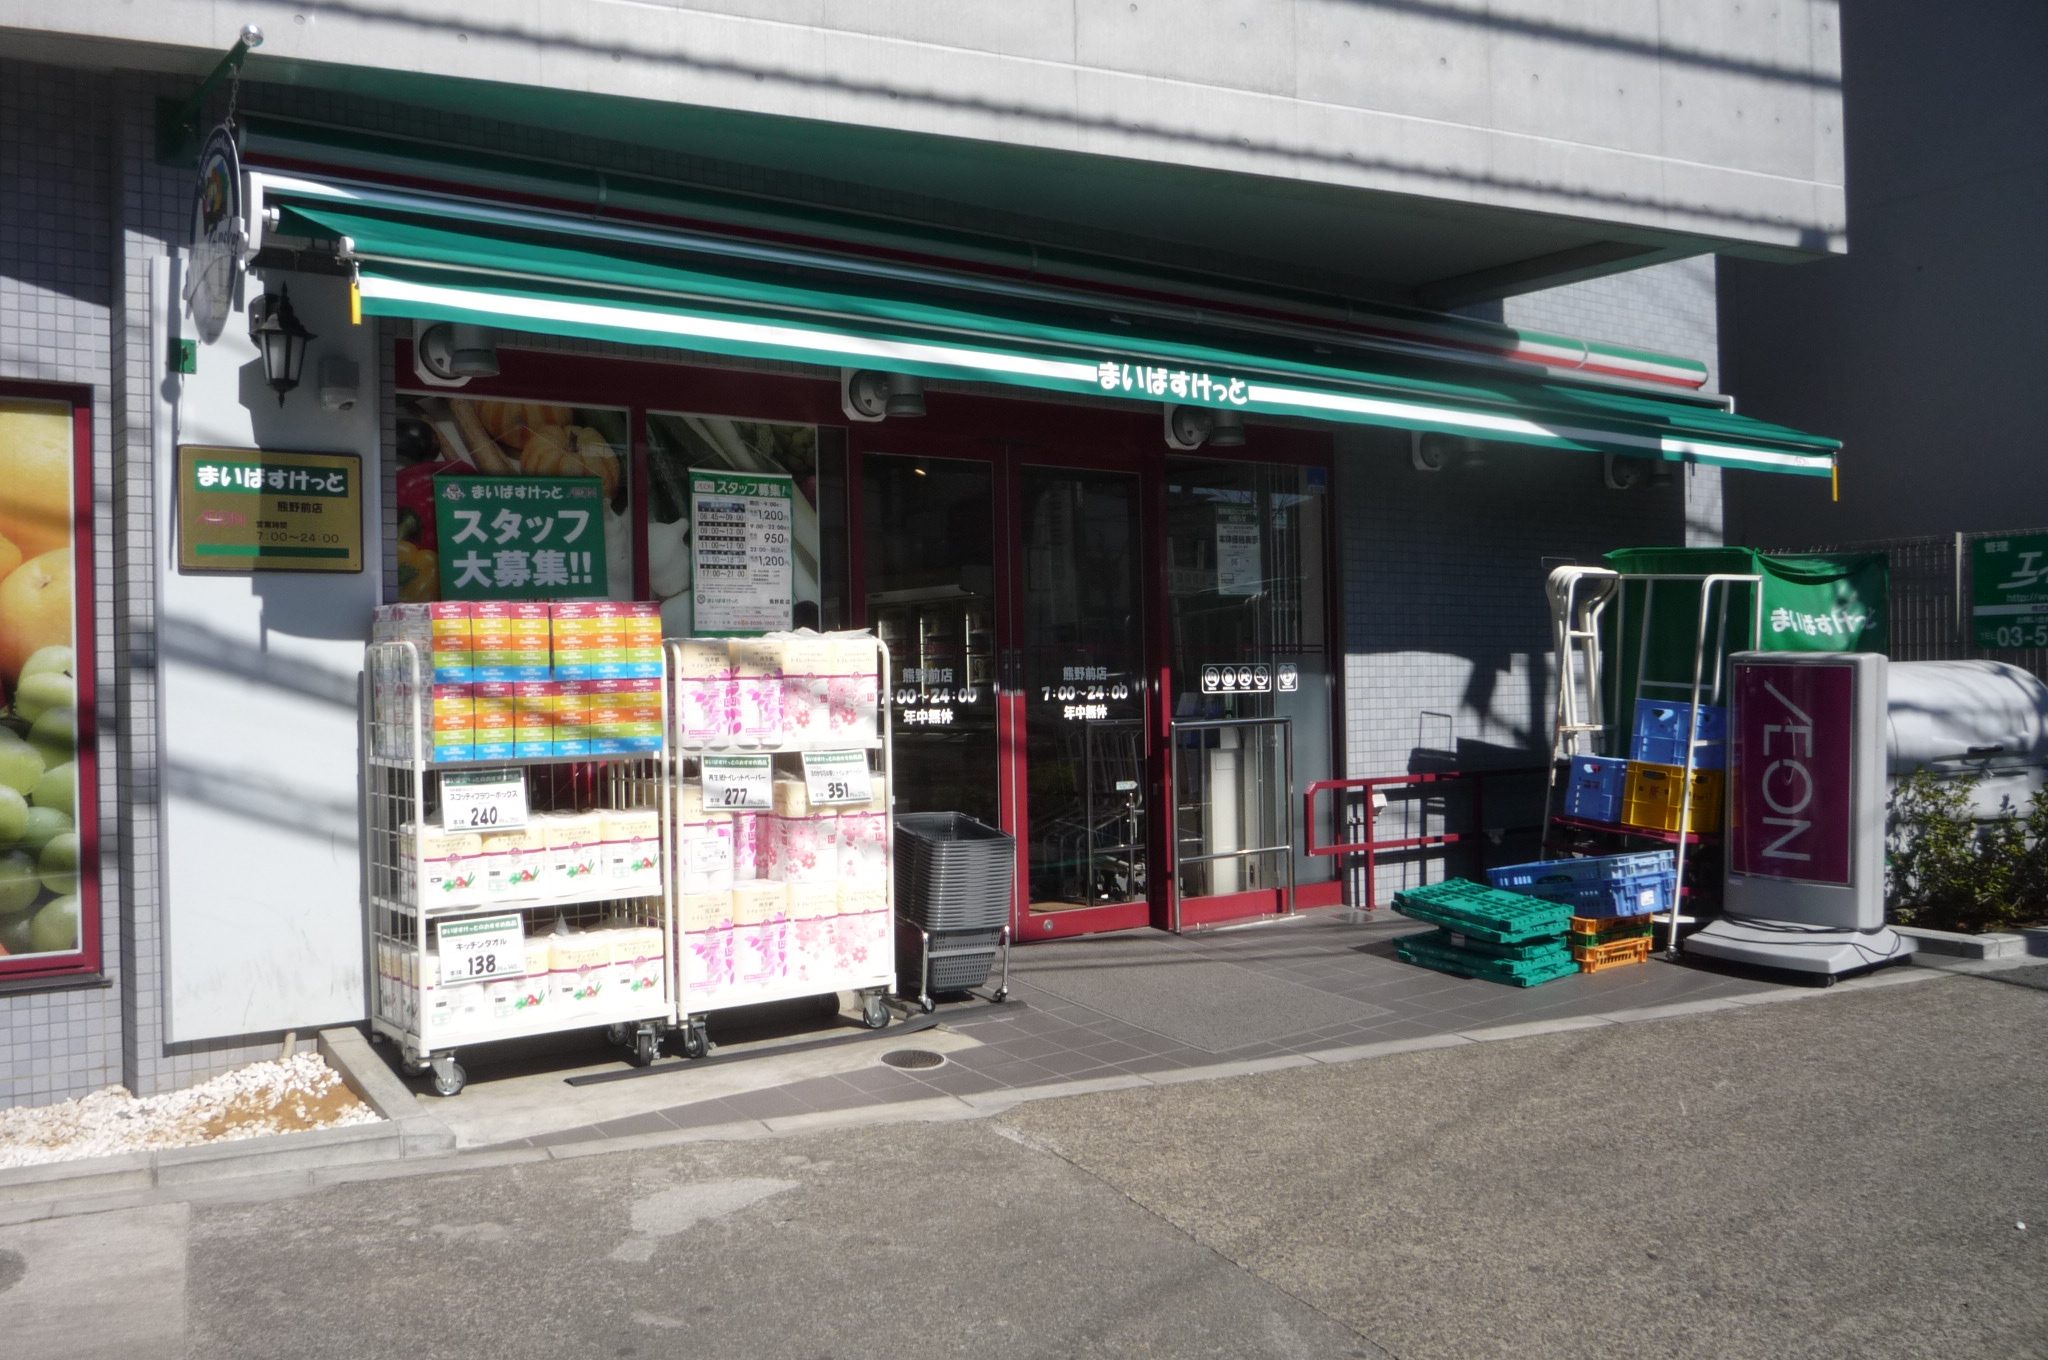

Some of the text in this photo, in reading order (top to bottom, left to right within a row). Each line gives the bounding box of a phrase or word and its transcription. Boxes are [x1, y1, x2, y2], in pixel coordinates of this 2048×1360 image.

[1098, 361, 1248, 405] まいばすけっと
[198, 465, 345, 493] まいばすけっと
[472, 485, 563, 499] まいばすけっと
[717, 481, 786, 496] スタッフ募集!
[277, 501, 322, 513] 熊野前店
[452, 508, 590, 545] スタッフ
[453, 550, 592, 588] 大募集!!
[1771, 607, 1878, 635] まいばすけっと
[903, 668, 953, 683] 熊野前店
[1063, 666, 1108, 681] 熊野前店
[903, 708, 953, 725] 年中無休
[1064, 704, 1108, 720] 年中無休
[1762, 680, 1813, 861] AEON
[724, 788, 748, 805] 277
[828, 782, 849, 799] 351
[470, 806, 498, 826] 240
[456, 938, 507, 951] キッチンタオル
[468, 954, 496, 976] 138
